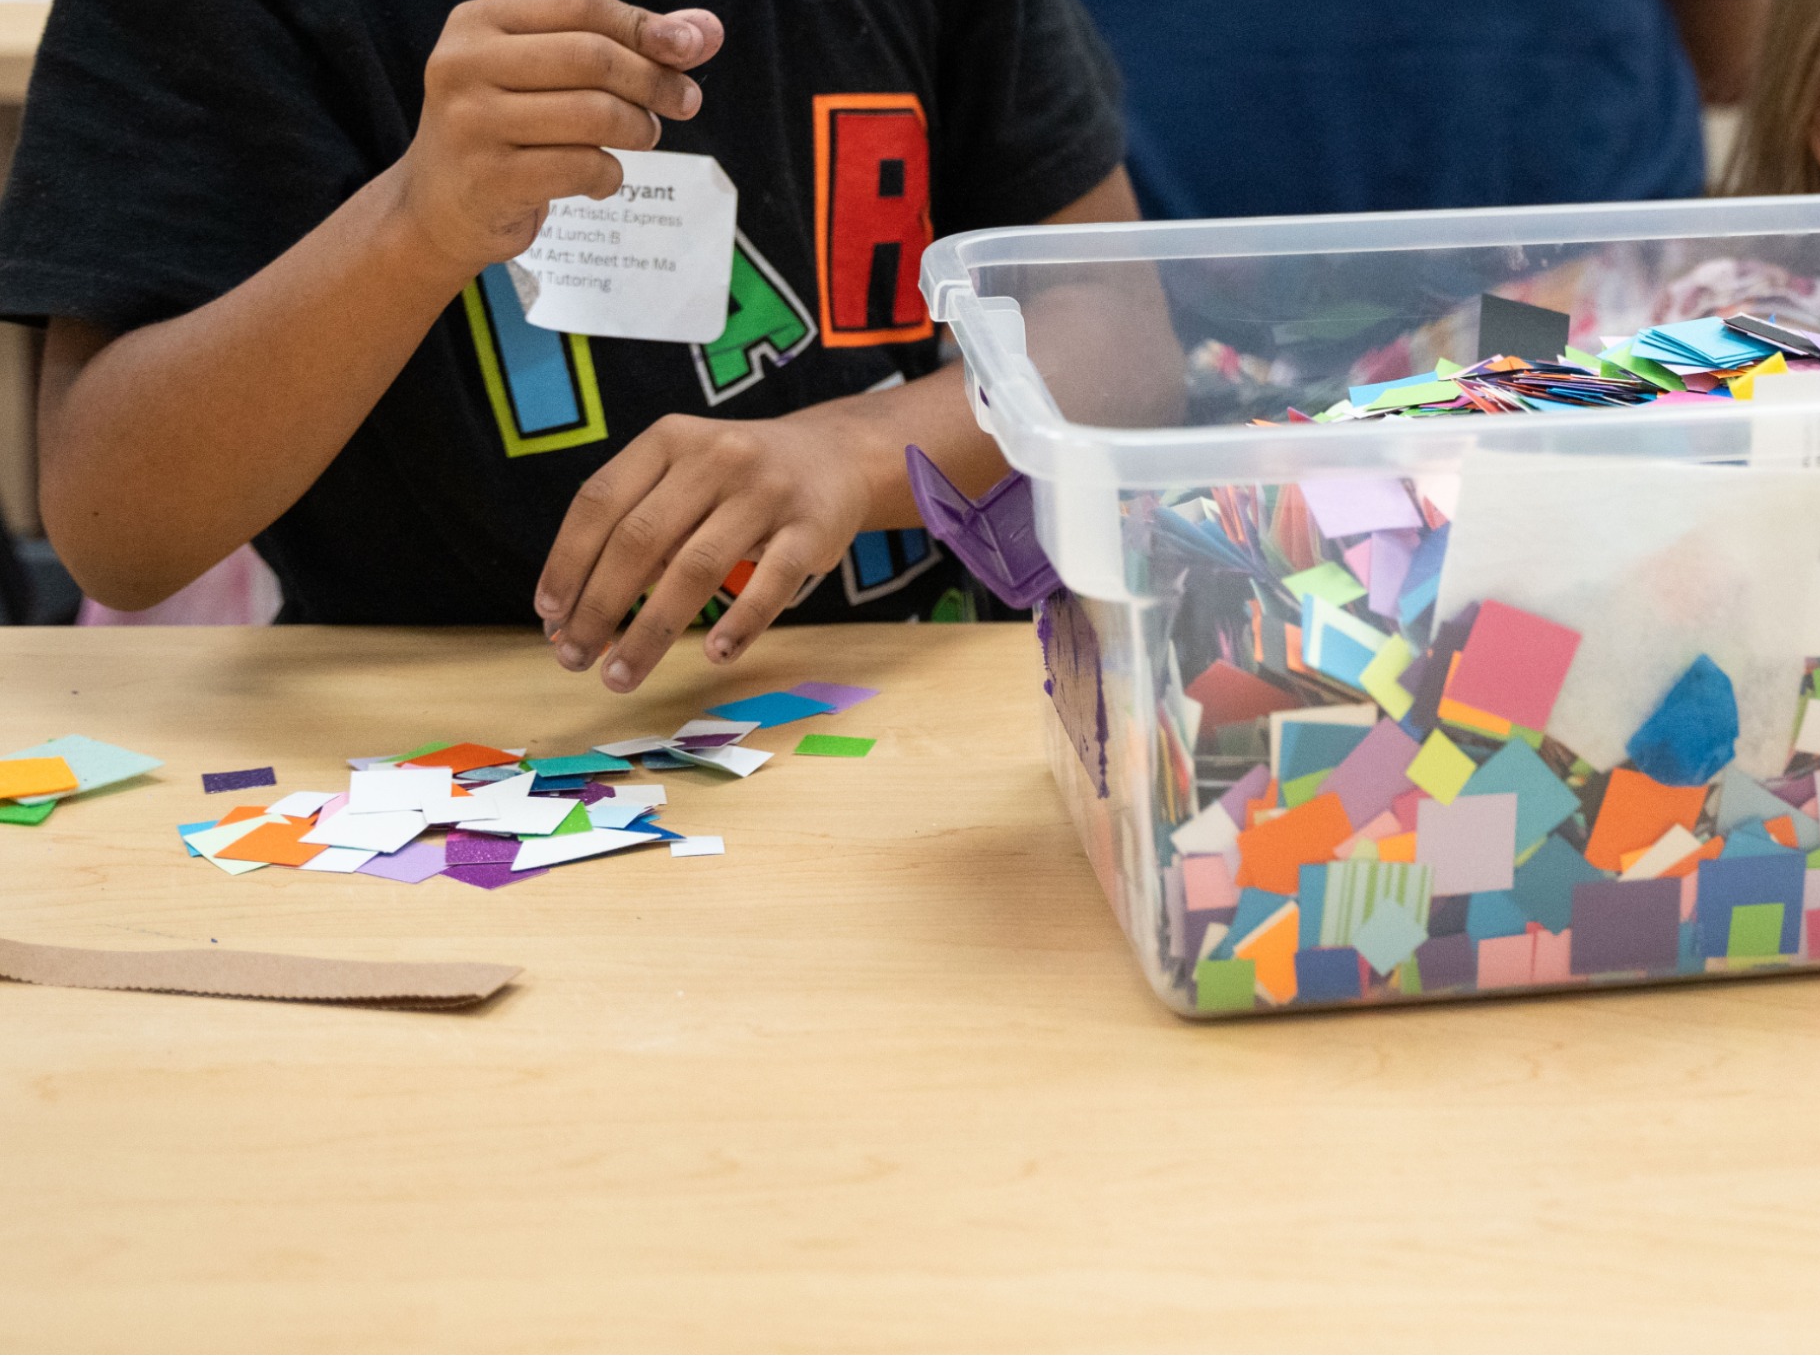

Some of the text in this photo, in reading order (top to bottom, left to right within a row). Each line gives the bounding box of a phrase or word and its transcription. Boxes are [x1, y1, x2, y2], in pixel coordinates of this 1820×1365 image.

[619, 184, 676, 202] ryant
[560, 204, 618, 223] Artistic
[623, 211, 683, 228] Express
[558, 227, 605, 243] Lunch
[547, 248, 575, 263] Art:
[579, 250, 618, 267] Meet
[623, 254, 650, 270] the
[547, 271, 612, 293] Tutoring
